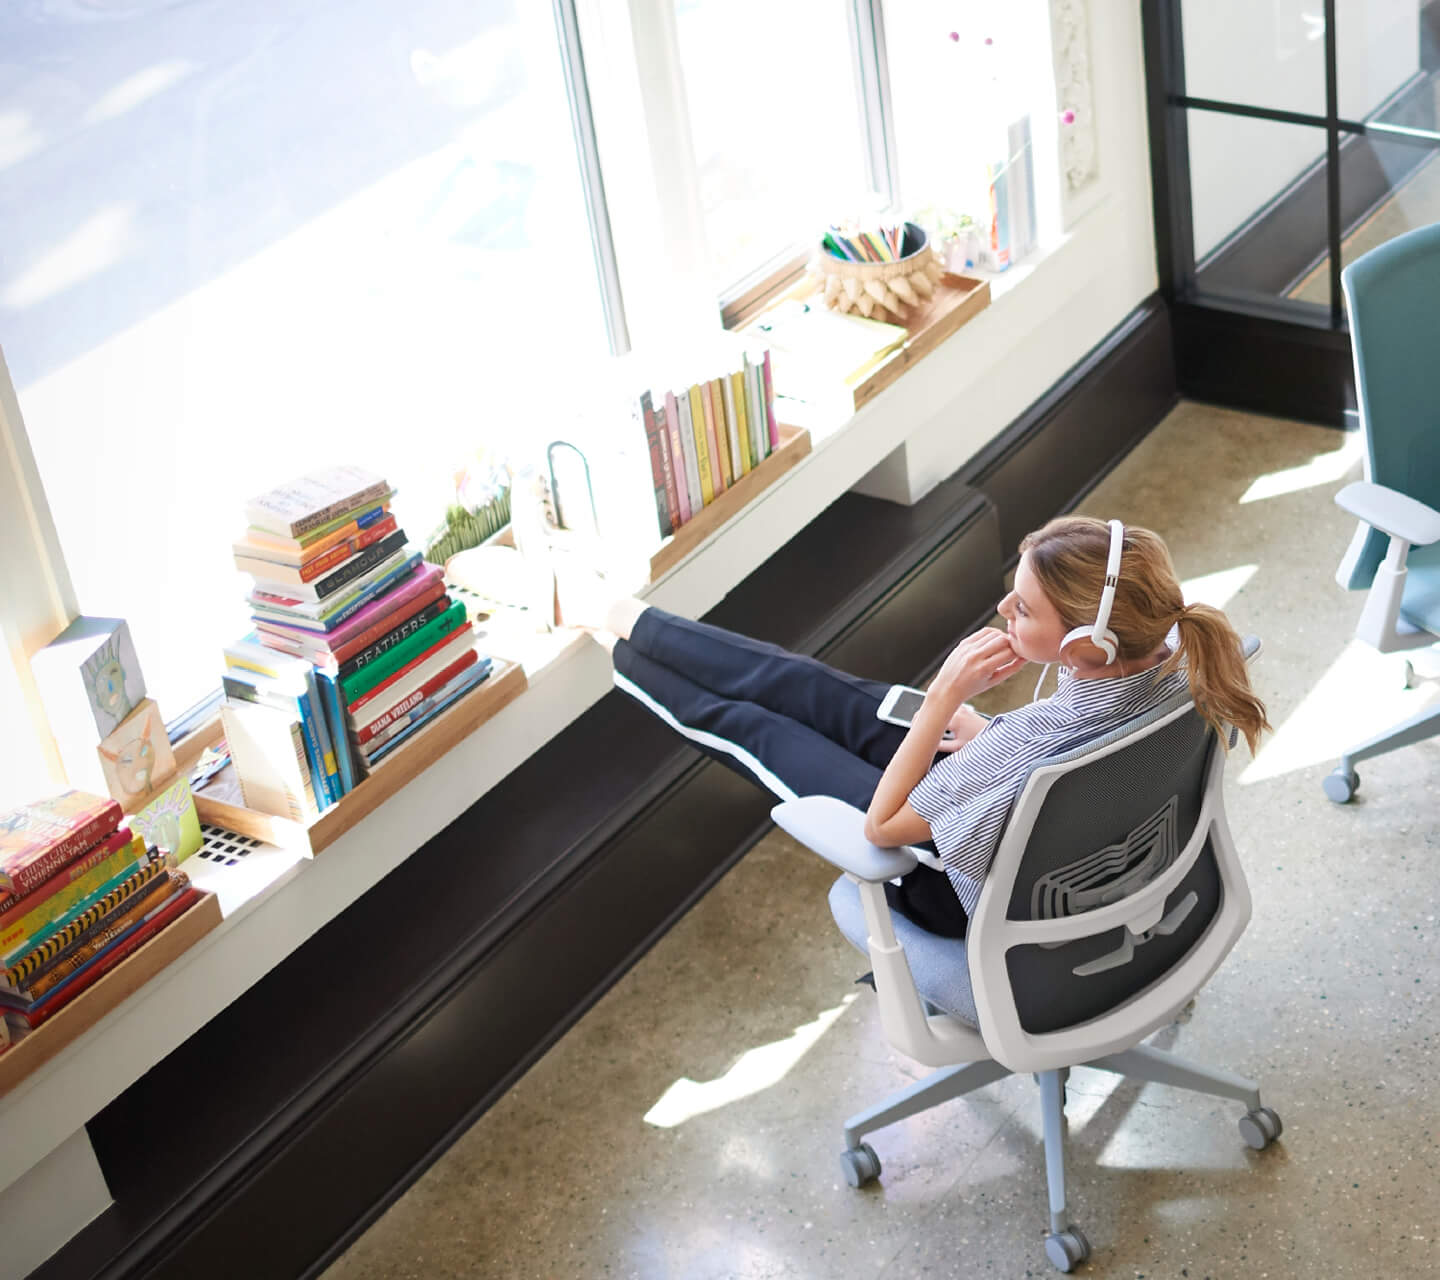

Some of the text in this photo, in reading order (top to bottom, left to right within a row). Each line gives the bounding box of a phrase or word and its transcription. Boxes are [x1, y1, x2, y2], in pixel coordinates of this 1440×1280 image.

[326, 545, 385, 589] GLAMOUR
[355, 613, 427, 669] FEATHERS
[370, 713, 393, 735] DIANA
[19, 839, 73, 881] CHINA CHIC
[22, 839, 89, 888] VIVIENNE TAM
